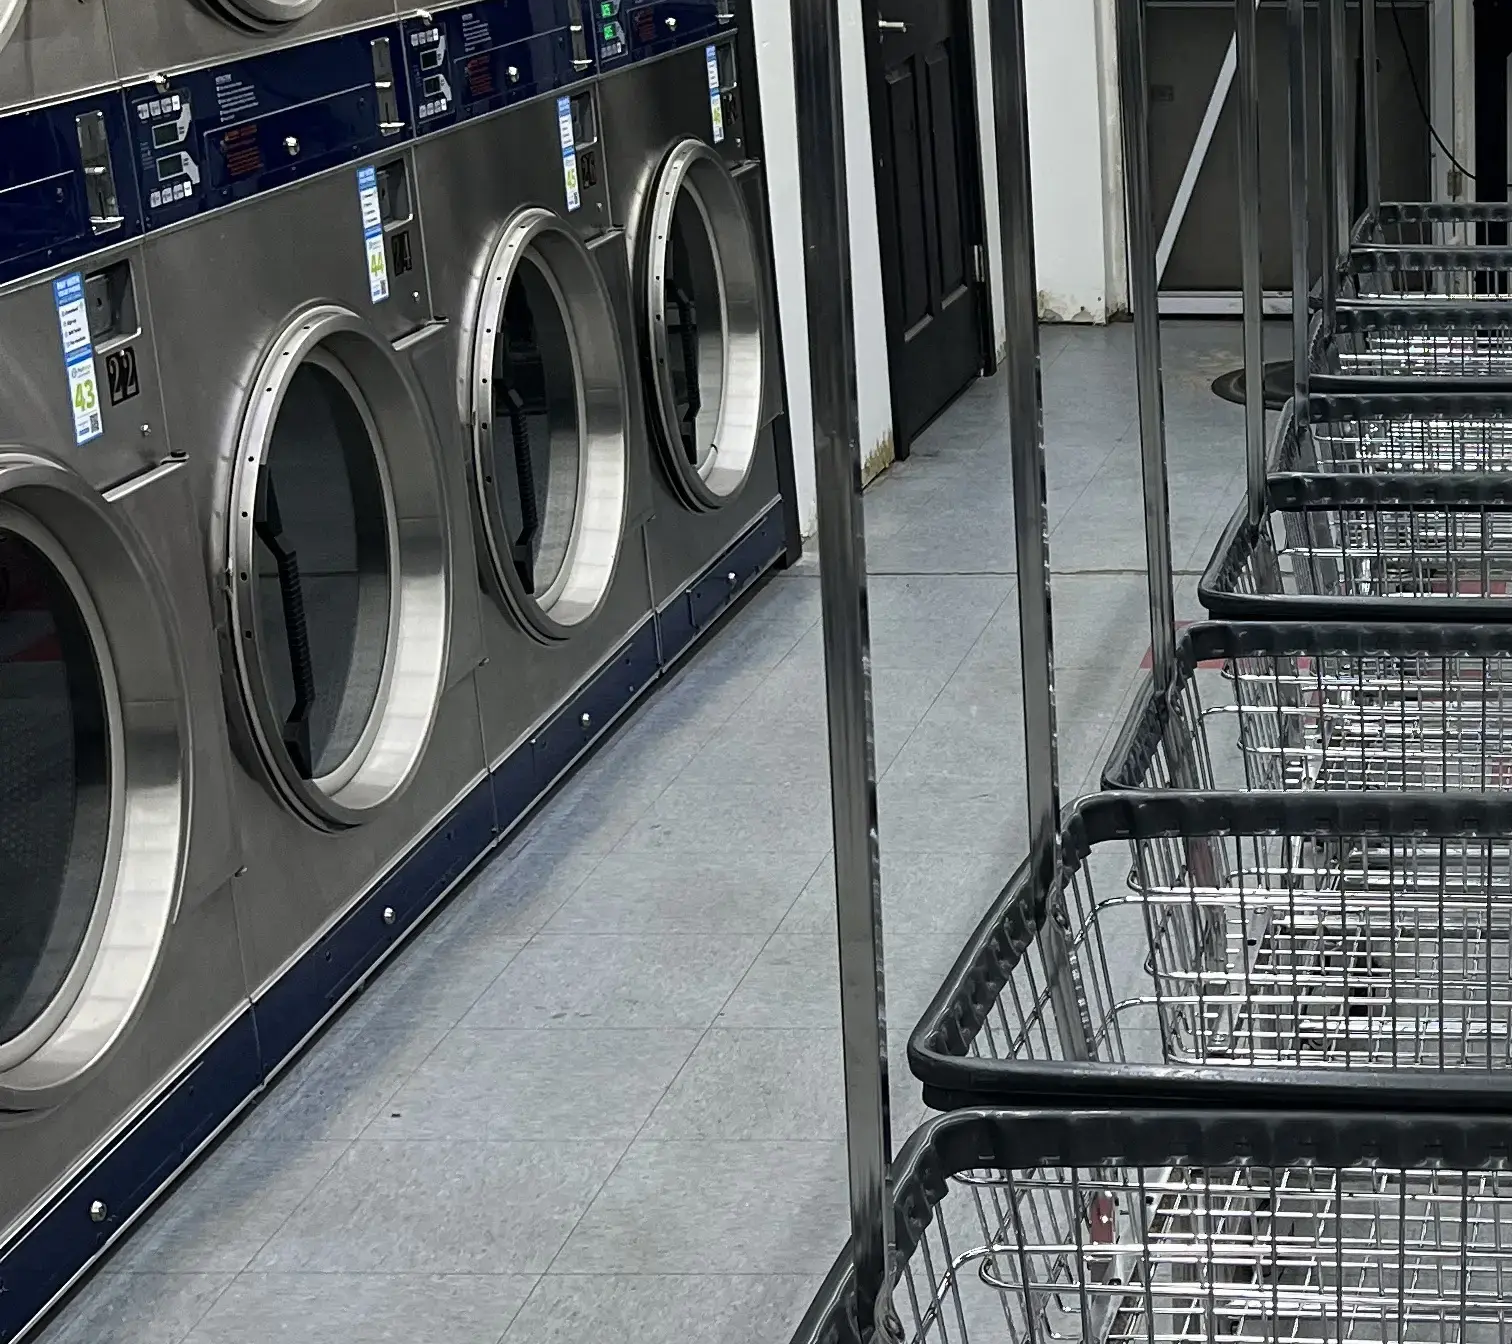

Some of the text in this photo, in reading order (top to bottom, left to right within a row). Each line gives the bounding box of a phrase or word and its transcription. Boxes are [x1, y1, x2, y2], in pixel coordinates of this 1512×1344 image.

[370, 251, 384, 278] 44
[109, 351, 136, 402] 22
[75, 379, 96, 412] 43
